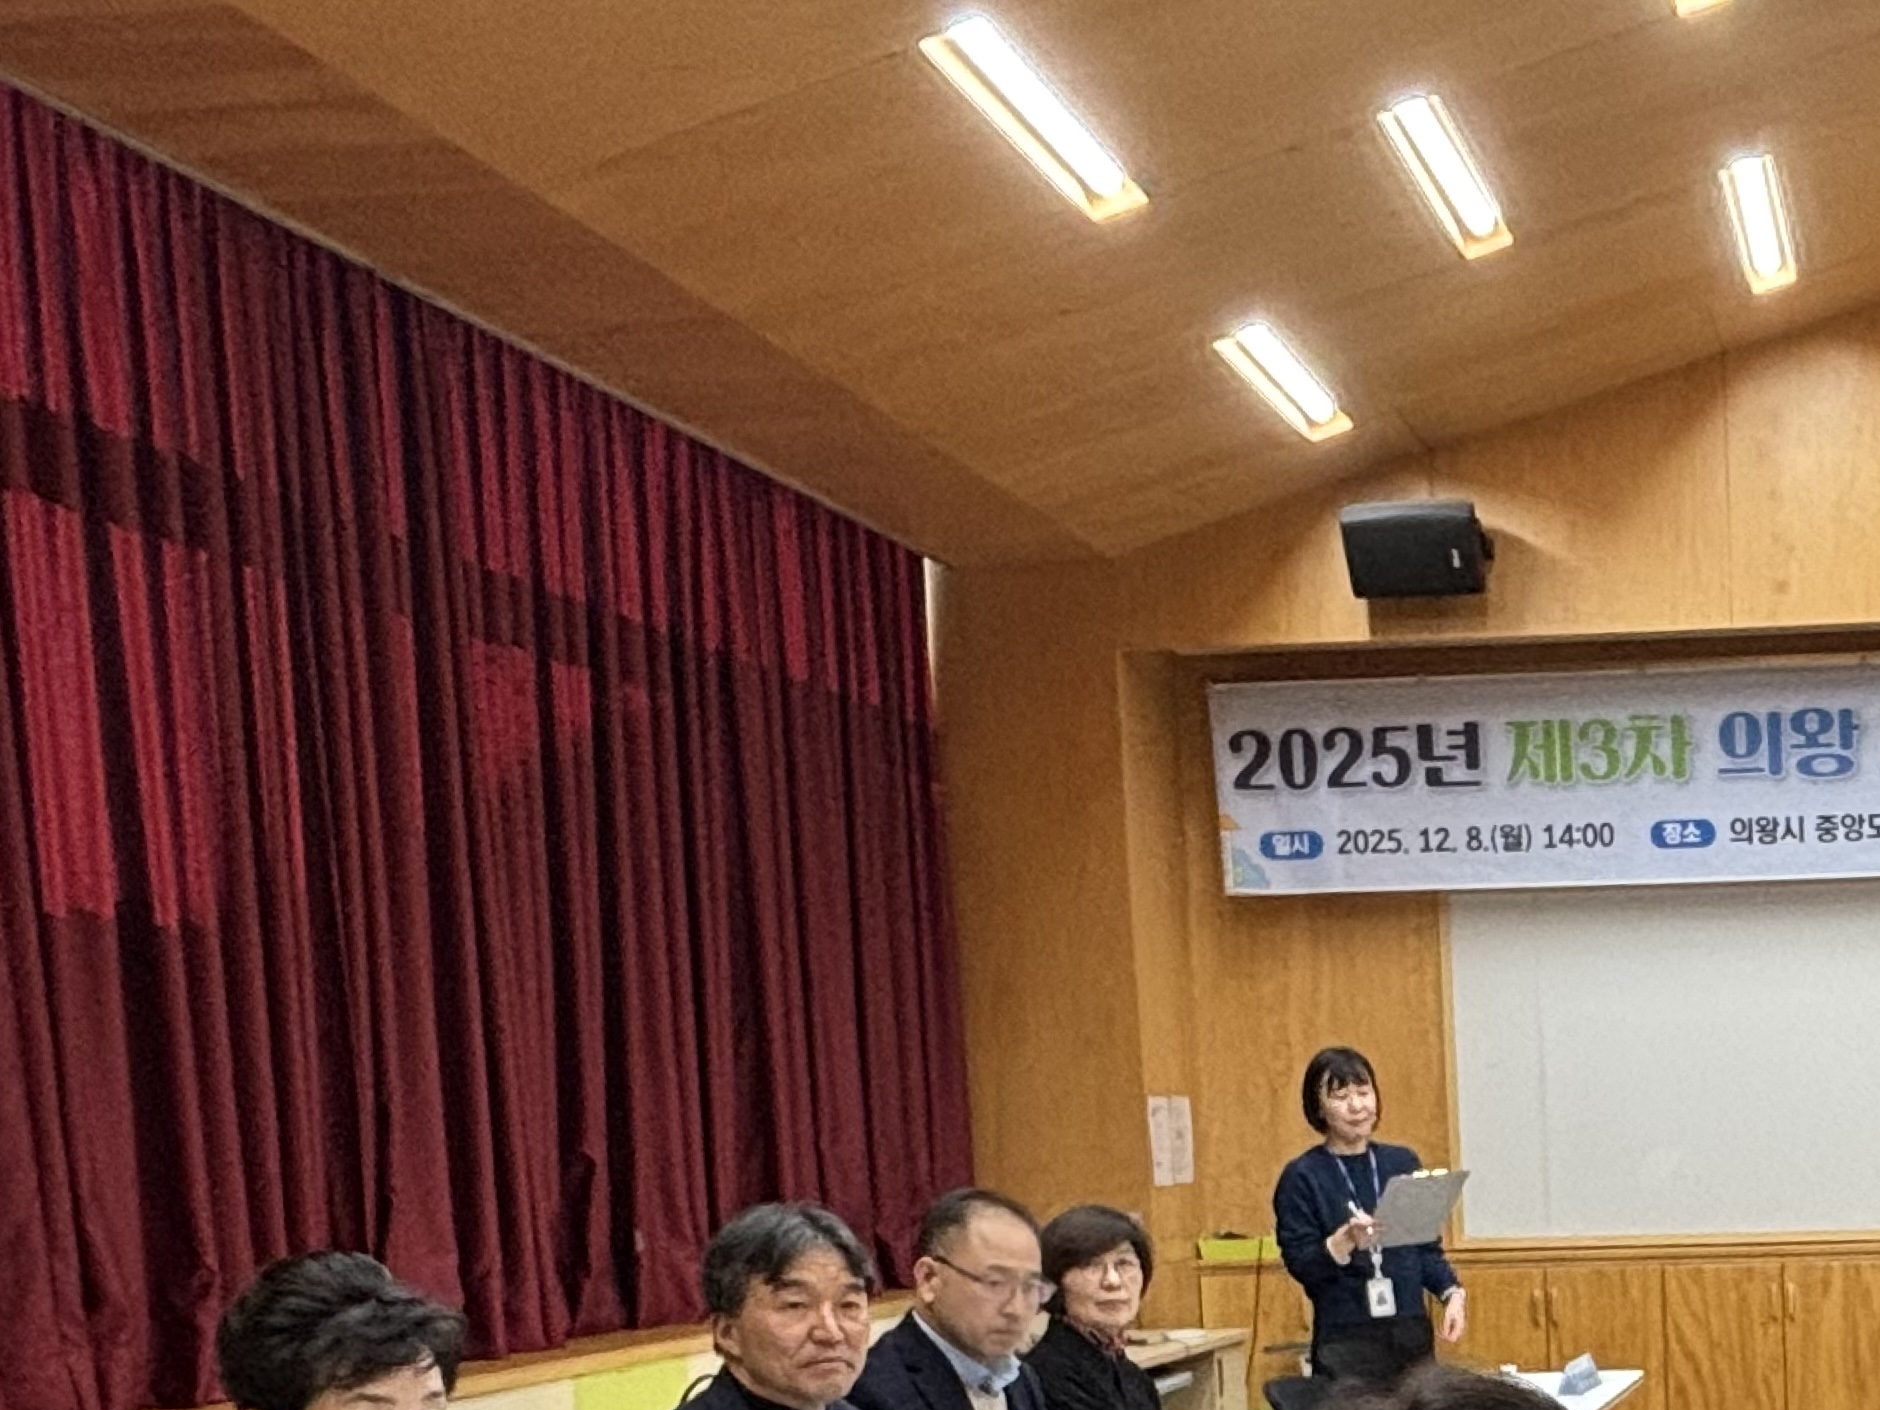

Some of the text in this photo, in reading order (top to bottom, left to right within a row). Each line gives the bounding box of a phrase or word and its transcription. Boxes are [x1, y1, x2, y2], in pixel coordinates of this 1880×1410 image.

[1228, 721, 1482, 790] 2025년
[1505, 713, 1693, 784] 제3차
[1718, 707, 1861, 778] 의왕
[1271, 822, 1616, 857] 일시 2025. 12. 8.(월) 14:00
[1661, 821, 1704, 846] 장소
[1728, 815, 1807, 846] 의왕시
